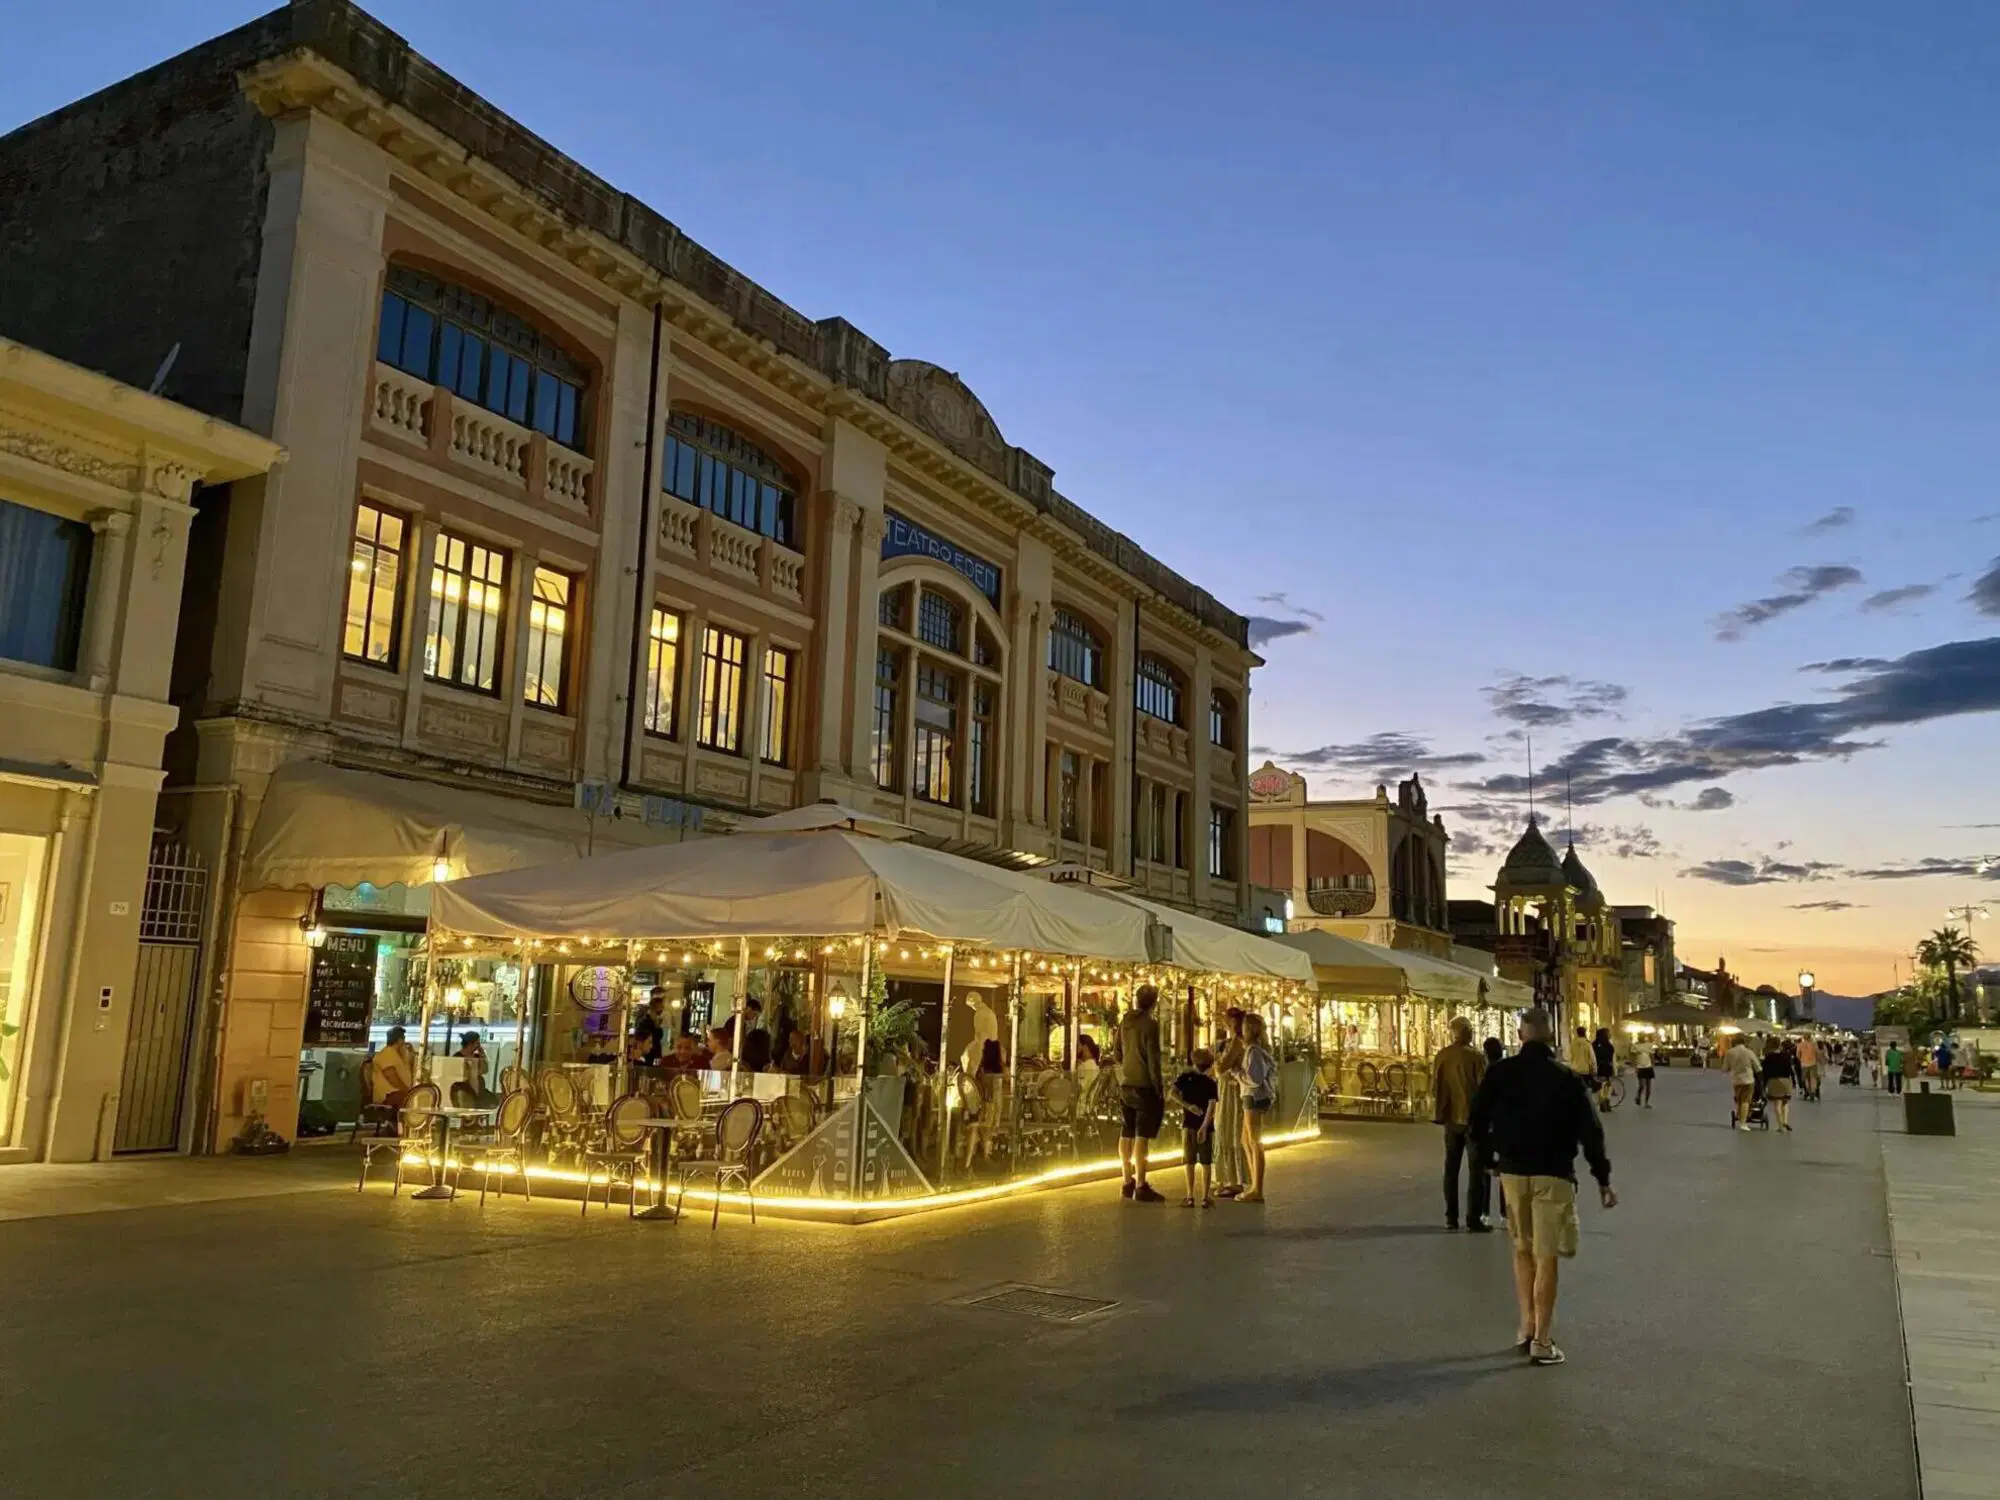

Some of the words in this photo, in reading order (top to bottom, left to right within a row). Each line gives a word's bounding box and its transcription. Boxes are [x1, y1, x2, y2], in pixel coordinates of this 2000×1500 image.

[884, 515, 952, 561] TEATRO
[954, 552, 996, 597] EDEN
[327, 937, 366, 953] MENU
[583, 985, 616, 1002] EDEN
